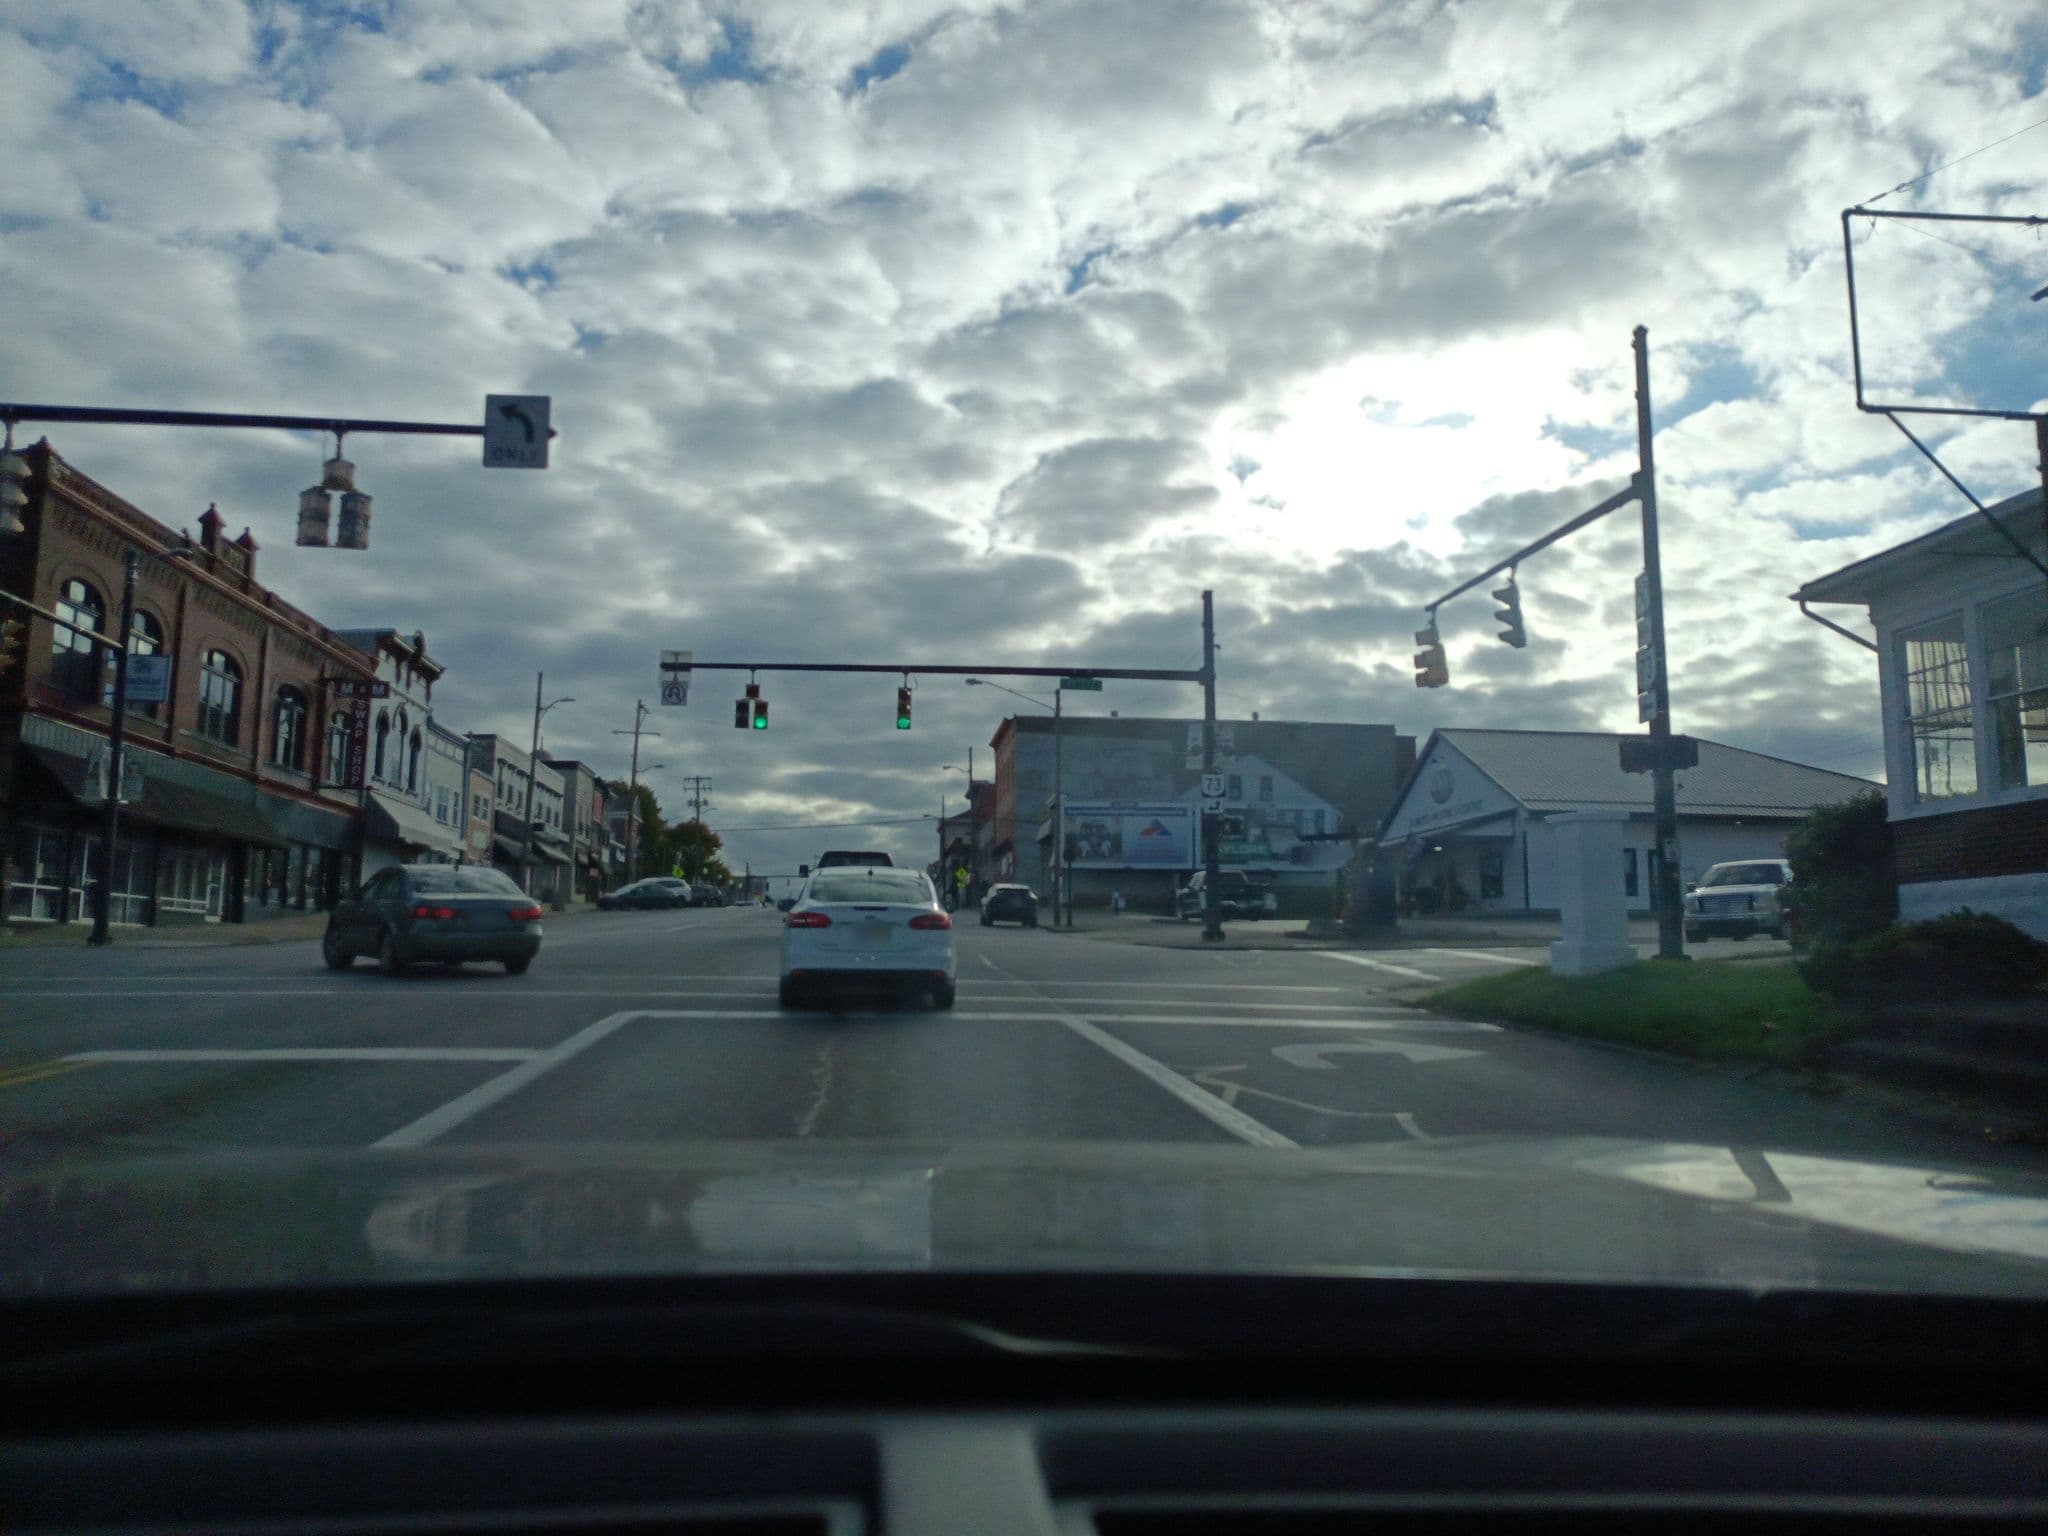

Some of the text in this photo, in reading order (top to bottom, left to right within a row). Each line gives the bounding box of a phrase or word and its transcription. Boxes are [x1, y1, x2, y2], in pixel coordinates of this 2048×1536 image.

[490, 447, 538, 462] ONLY
[341, 682, 354, 694] M
[372, 684, 385, 696] M
[351, 700, 366, 784] SWAP SHOP
[1206, 777, 1221, 791] 73
